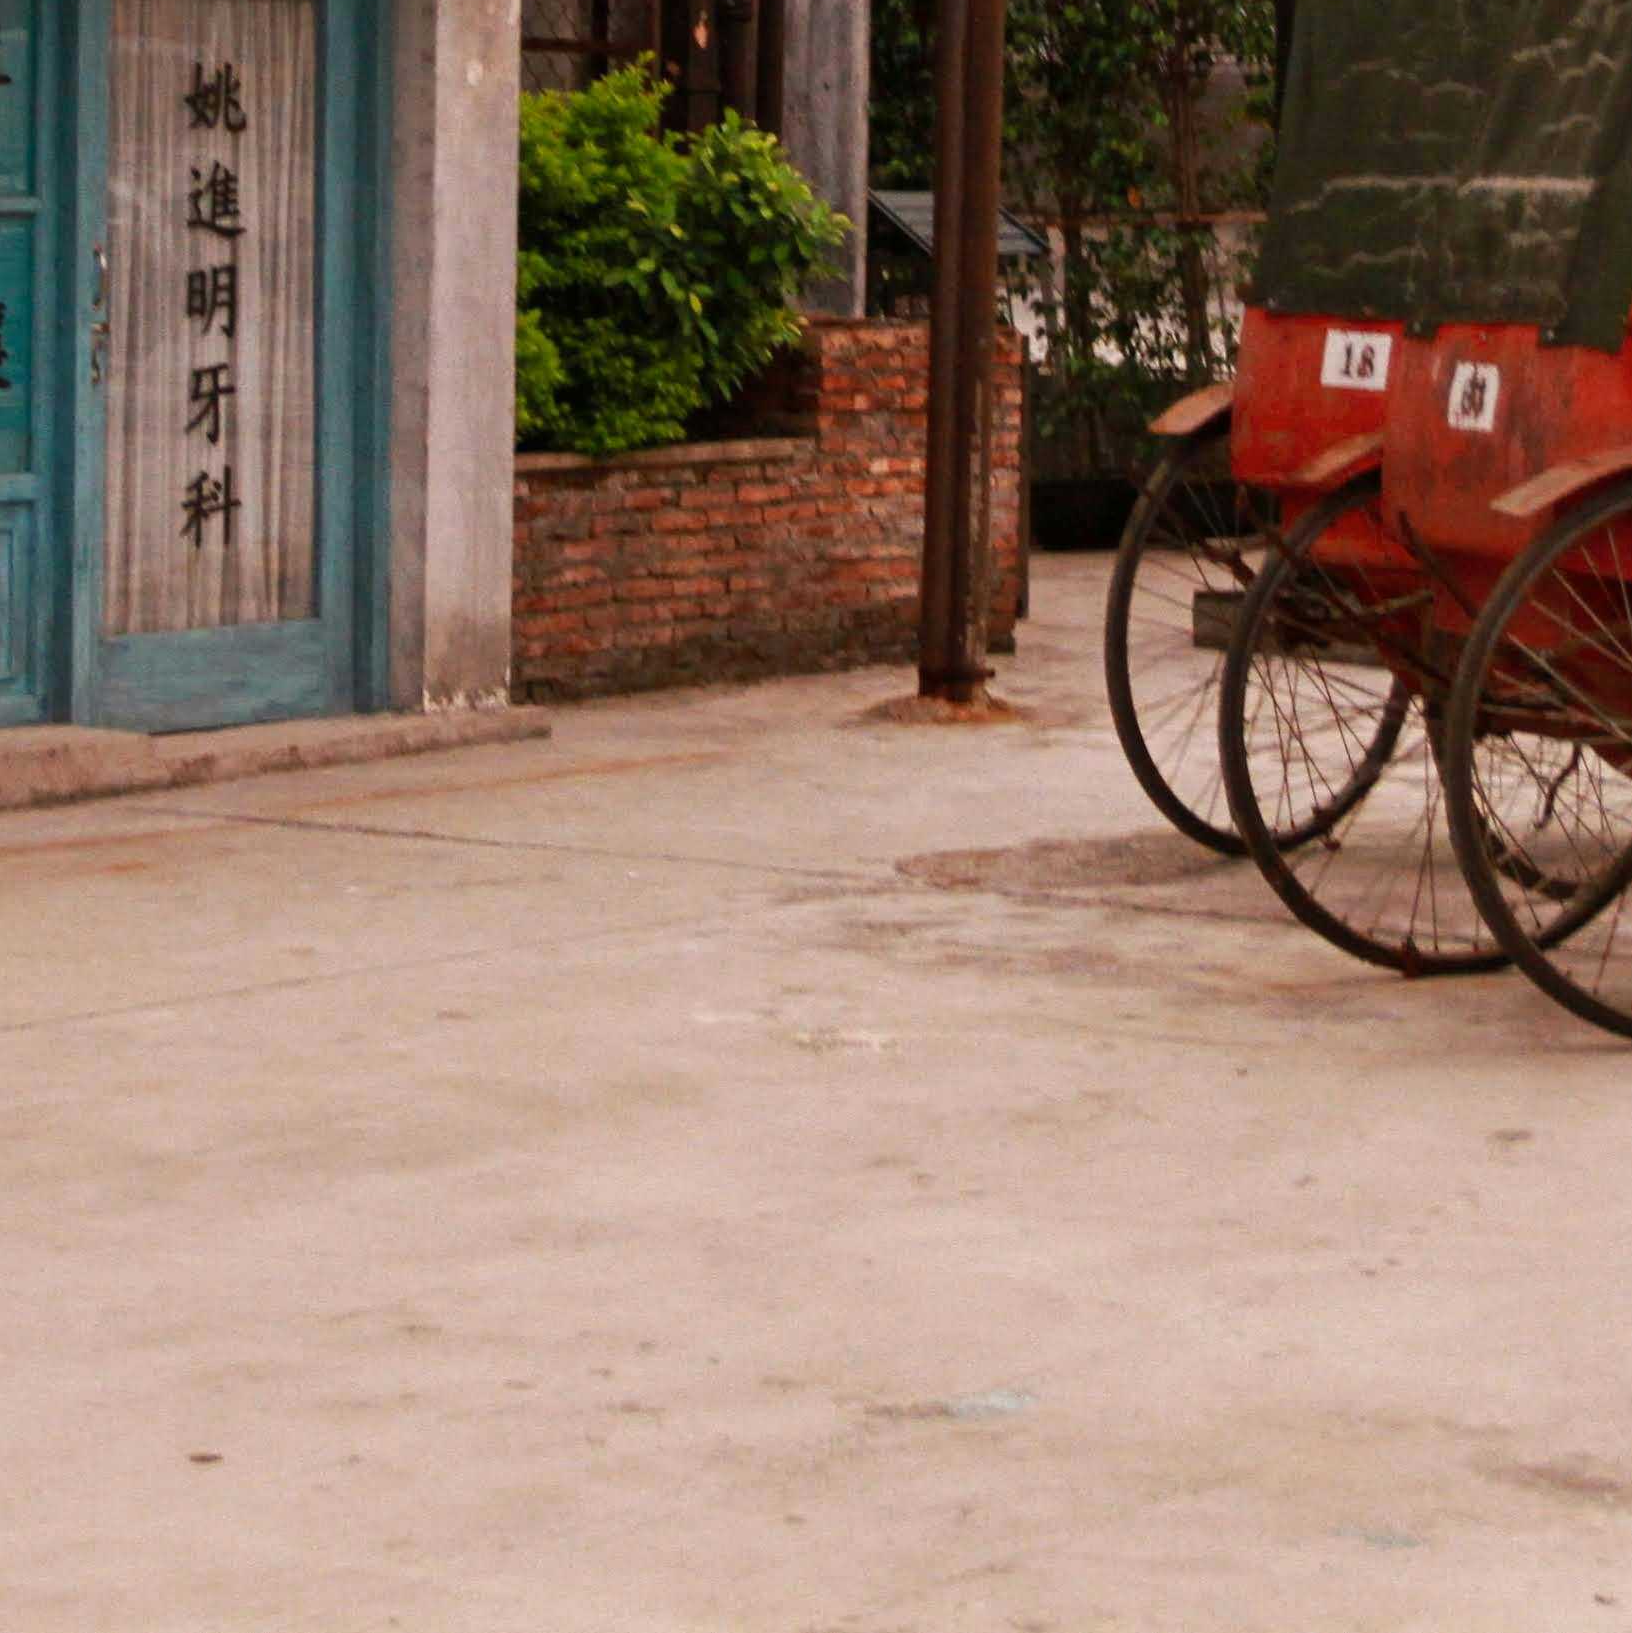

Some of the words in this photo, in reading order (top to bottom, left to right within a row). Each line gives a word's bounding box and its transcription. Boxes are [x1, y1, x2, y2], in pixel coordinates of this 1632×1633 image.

[180, 61, 247, 550] 姚進明牙科
